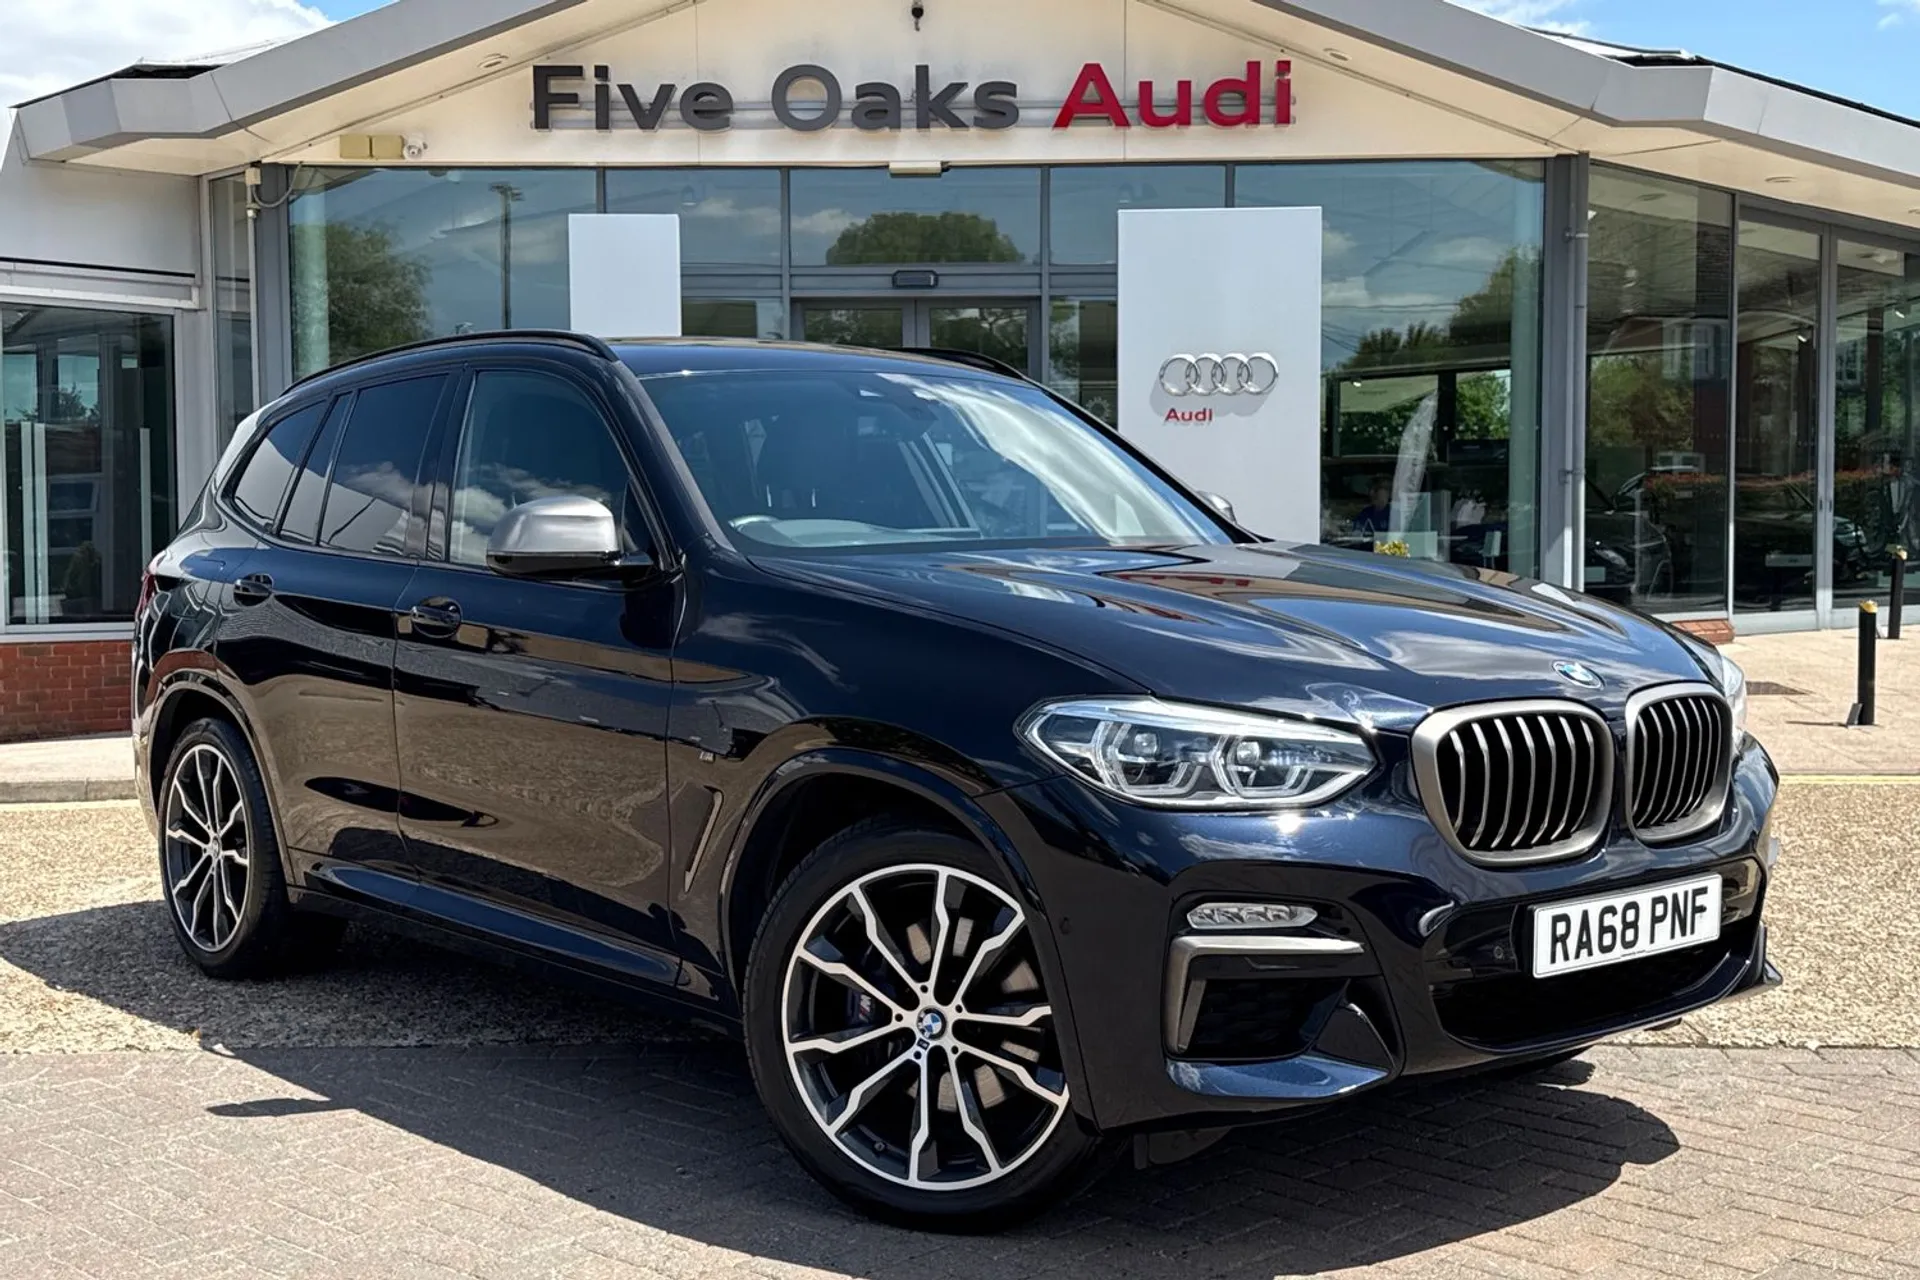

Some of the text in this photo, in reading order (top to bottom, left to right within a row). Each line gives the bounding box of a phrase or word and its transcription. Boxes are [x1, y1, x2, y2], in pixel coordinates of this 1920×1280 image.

[533, 60, 1292, 131] Five Oaks Audi
[1164, 408, 1213, 422] Audi
[1550, 886, 1709, 964] RA68 PNF
